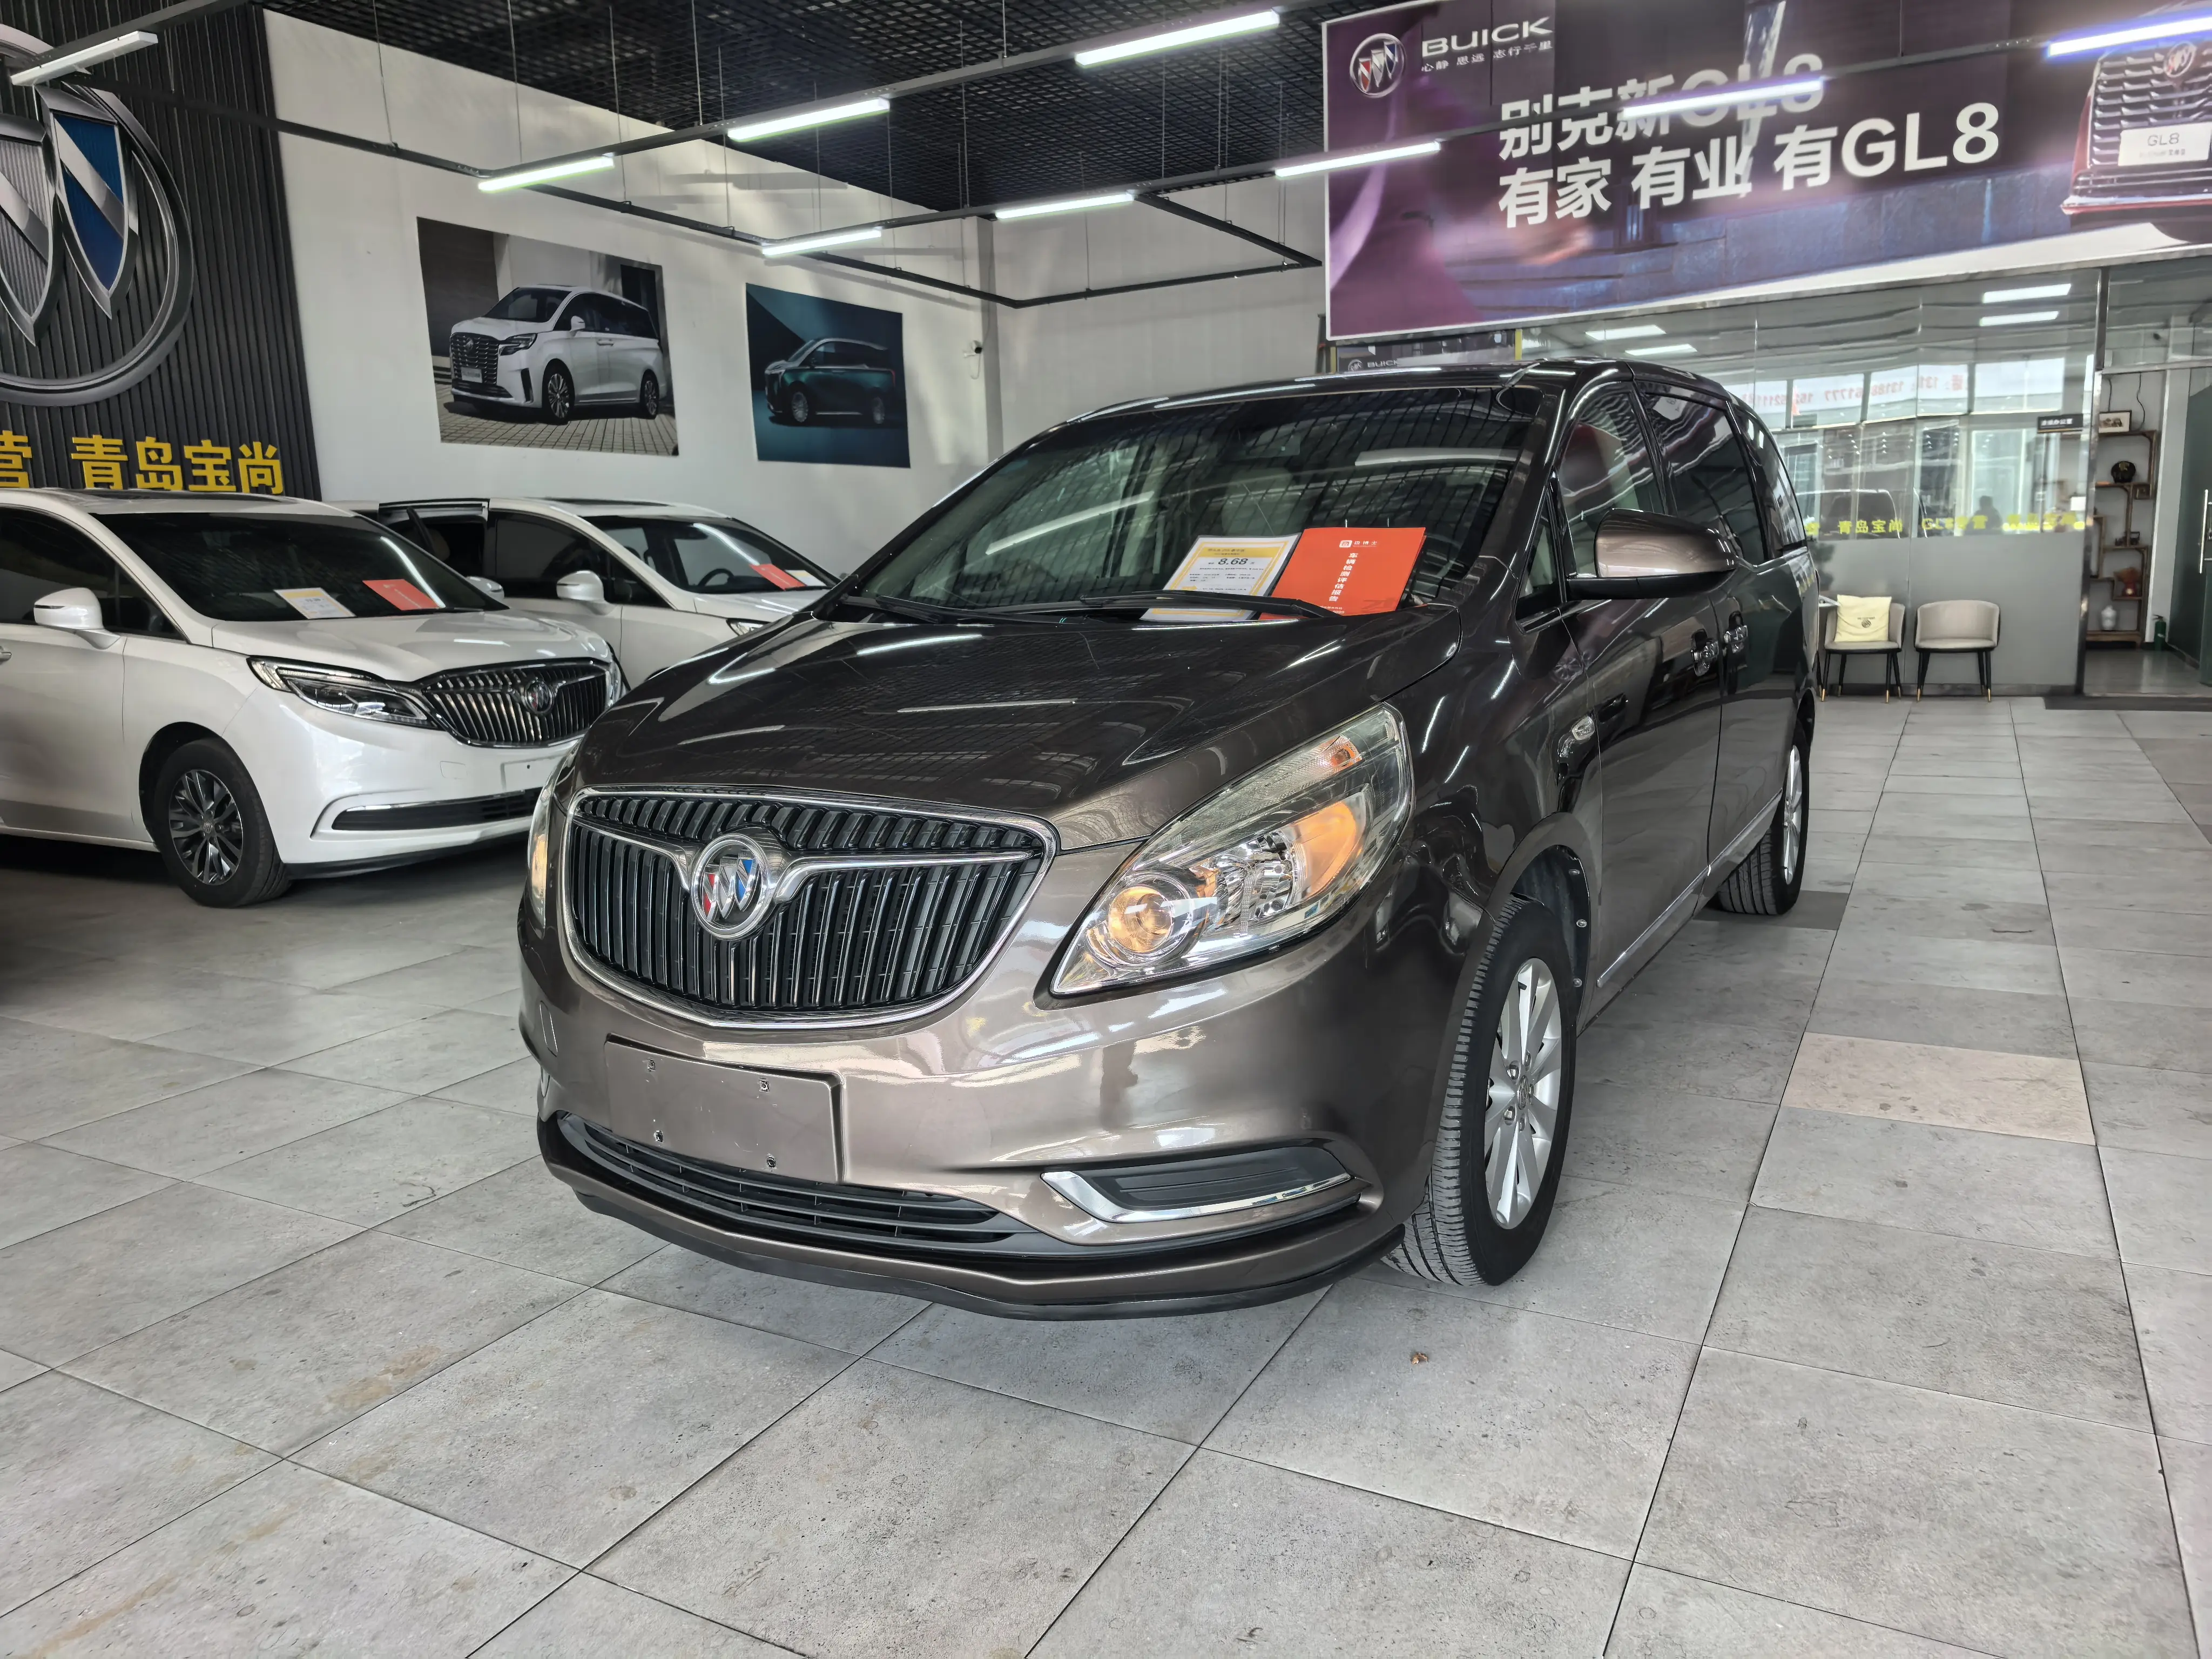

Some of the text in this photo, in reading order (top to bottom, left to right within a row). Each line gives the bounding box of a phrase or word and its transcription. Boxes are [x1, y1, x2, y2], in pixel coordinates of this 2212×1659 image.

[1422, 21, 1553, 58] BUICK
[2147, 132, 2180, 147] GL8
[1499, 102, 1999, 228] 有家 有业 有GL8
[71, 434, 284, 495] 青岛宝尚
[1838, 518, 1903, 534] 青岛宝尚
